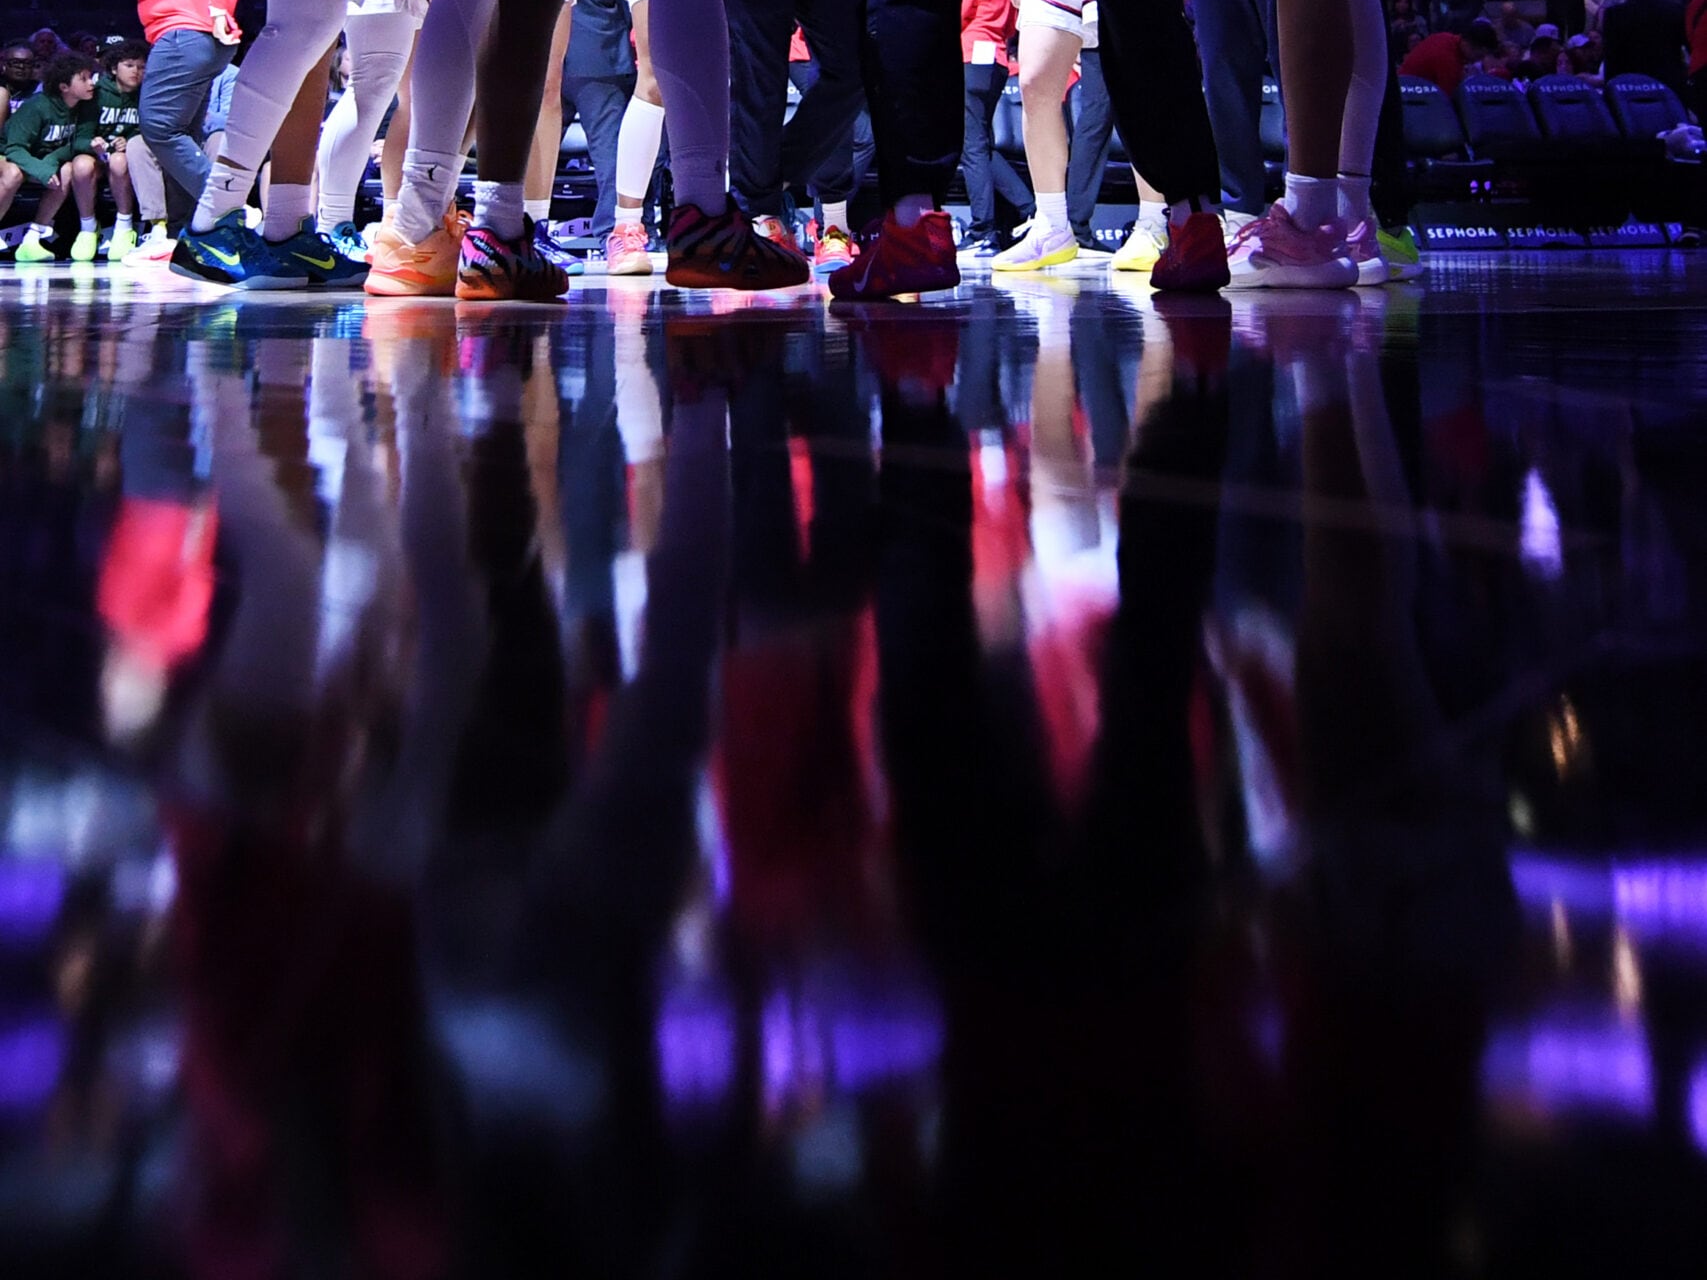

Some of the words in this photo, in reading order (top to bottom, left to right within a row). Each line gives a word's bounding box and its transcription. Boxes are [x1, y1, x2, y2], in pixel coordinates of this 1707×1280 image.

[1427, 225, 1498, 239] SEPHORA
[1508, 225, 1578, 239] SEPHORA
[1589, 223, 1659, 238] SEPHORA
